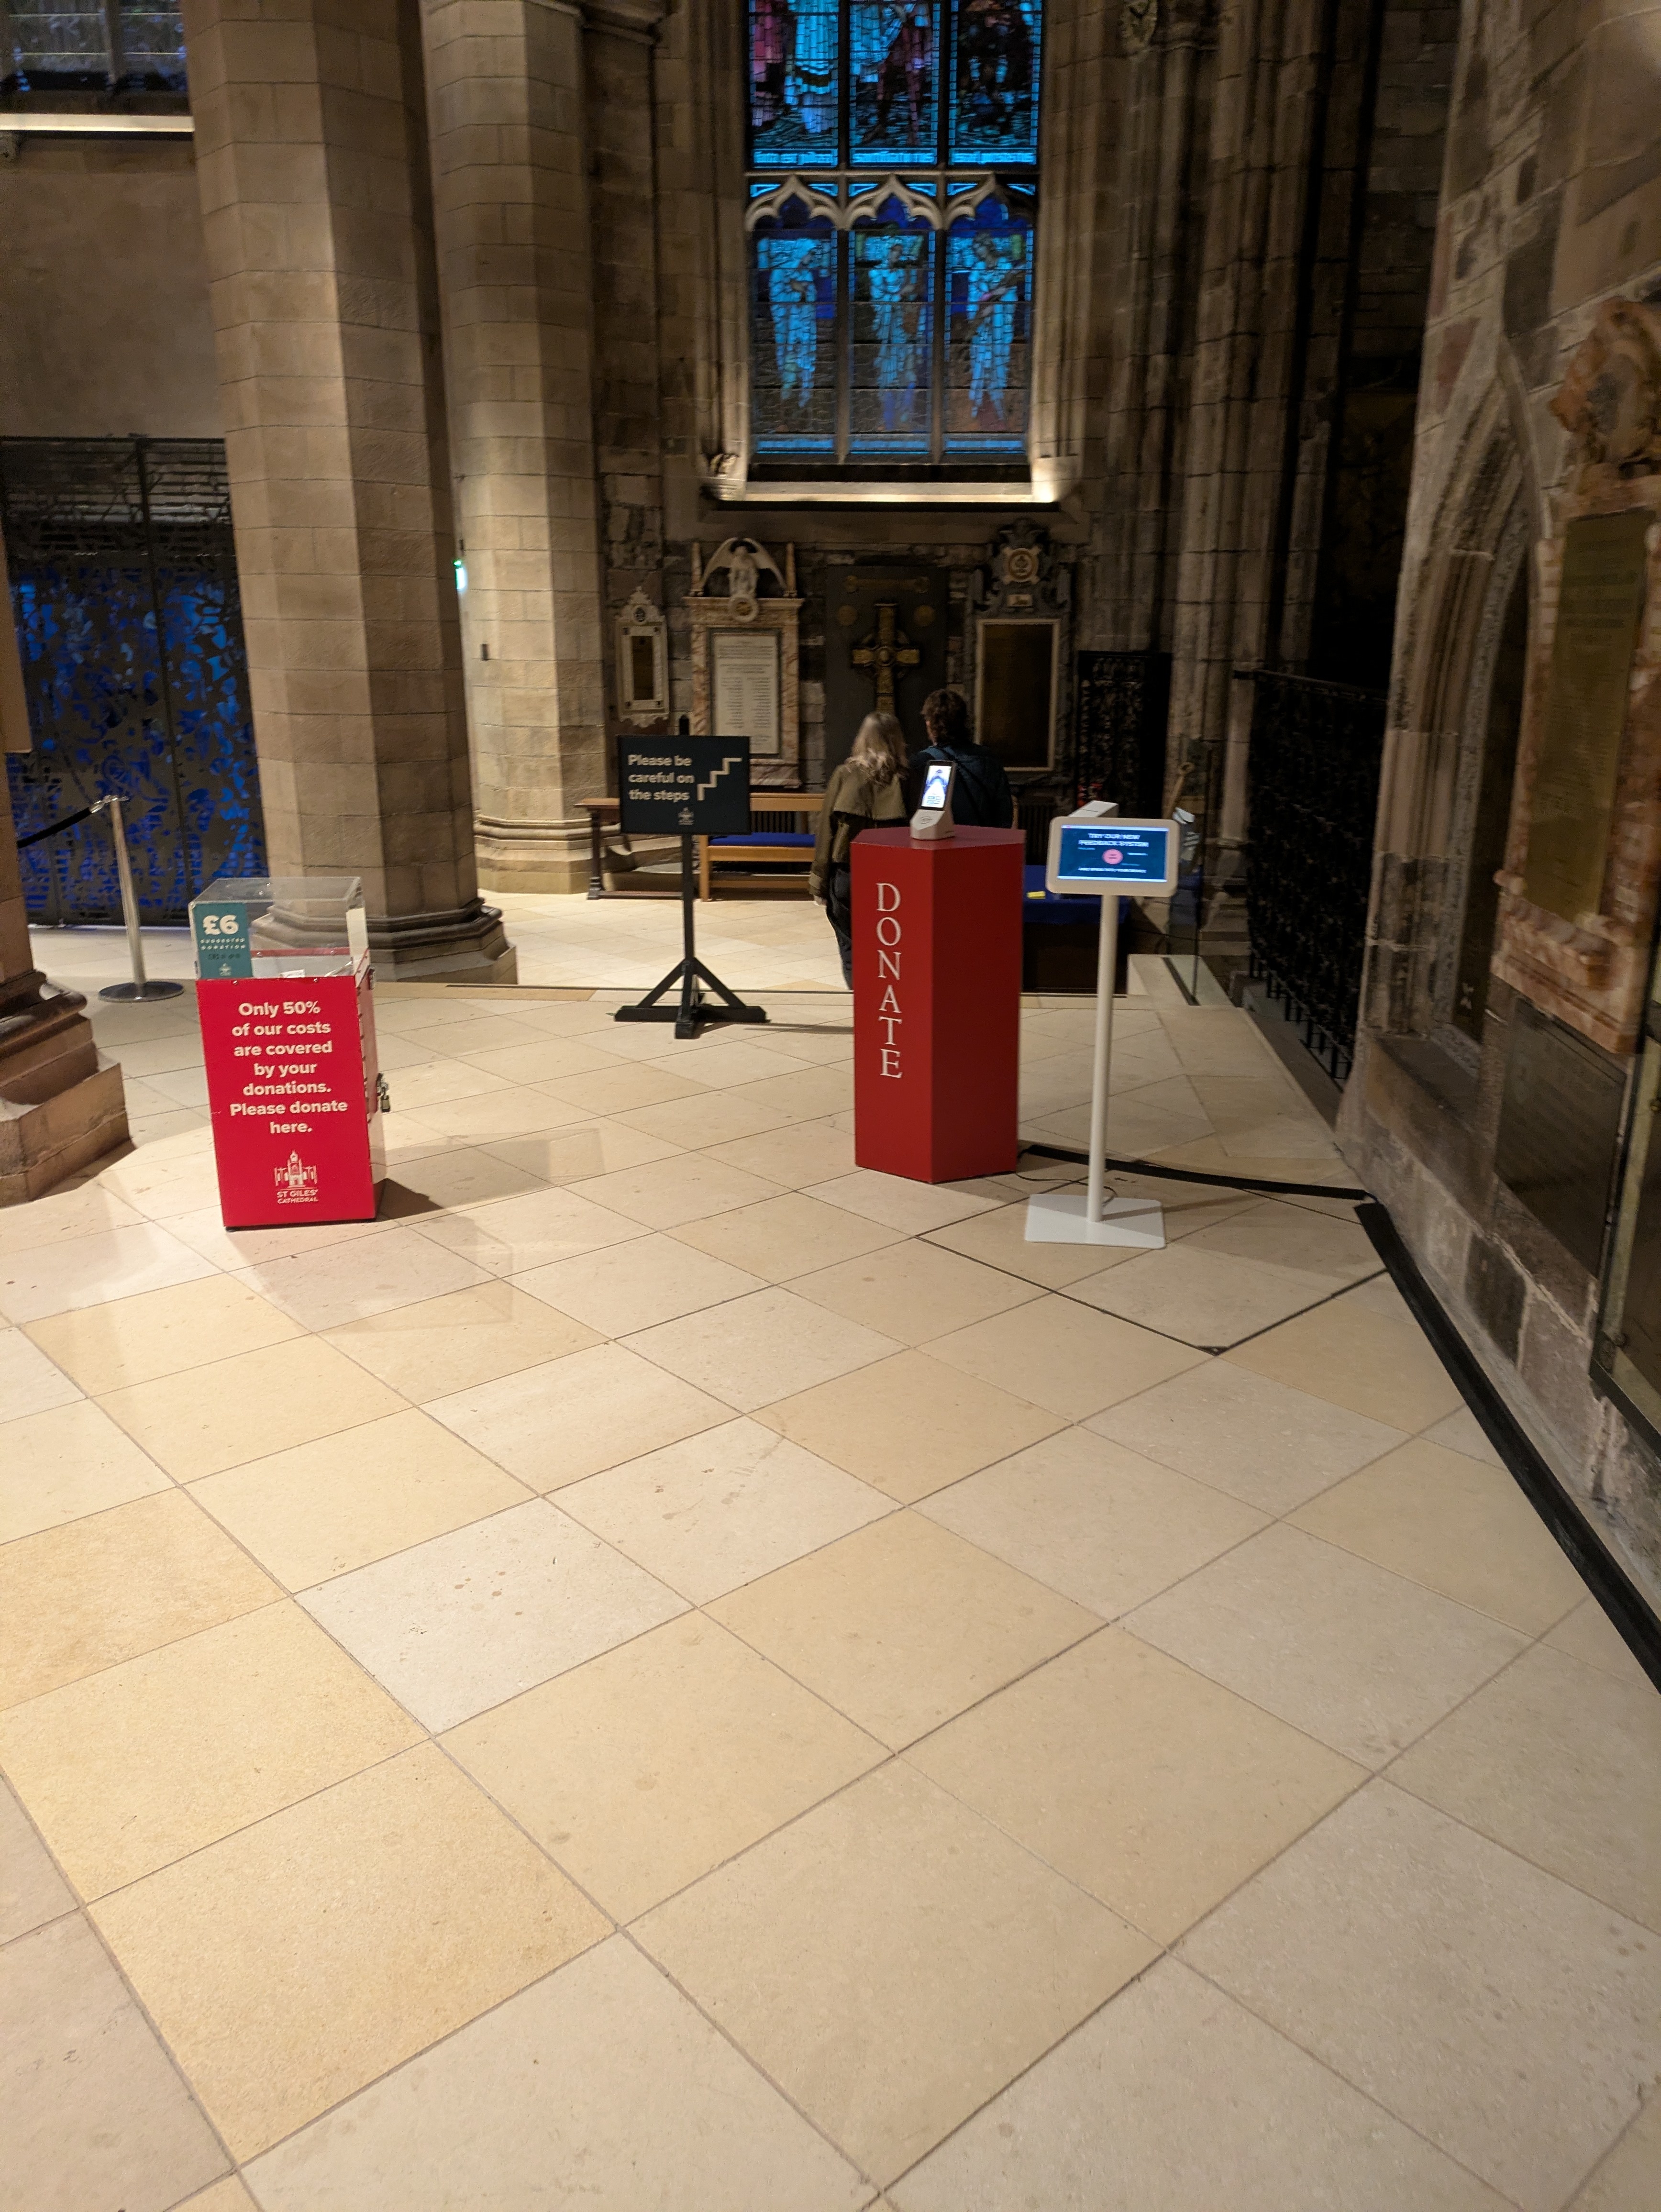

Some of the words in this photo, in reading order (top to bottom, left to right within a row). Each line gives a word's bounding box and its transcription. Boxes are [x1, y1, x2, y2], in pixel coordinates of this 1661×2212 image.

[628, 754, 672, 766] Please
[674, 755, 692, 766] be
[628, 772, 675, 783] careful
[676, 774, 695, 783] on
[628, 789, 652, 800] the
[653, 790, 690, 803] steps
[202, 914, 239, 936] £6
[876, 883, 903, 1079] DONATE
[238, 1002, 279, 1018] Only
[283, 1000, 321, 1015] 50%
[232, 1023, 250, 1037] of
[254, 1025, 283, 1036] our
[287, 1021, 331, 1035] costs
[233, 1045, 262, 1057] are
[266, 1040, 333, 1056] covered
[254, 1063, 275, 1078] by
[278, 1063, 317, 1078] your
[243, 1080, 332, 1096] donations.
[230, 1102, 286, 1117] Please
[289, 1100, 348, 1114] donate
[269, 1121, 313, 1134] here.
[277, 1196, 319, 1204] CATHEDRAL
